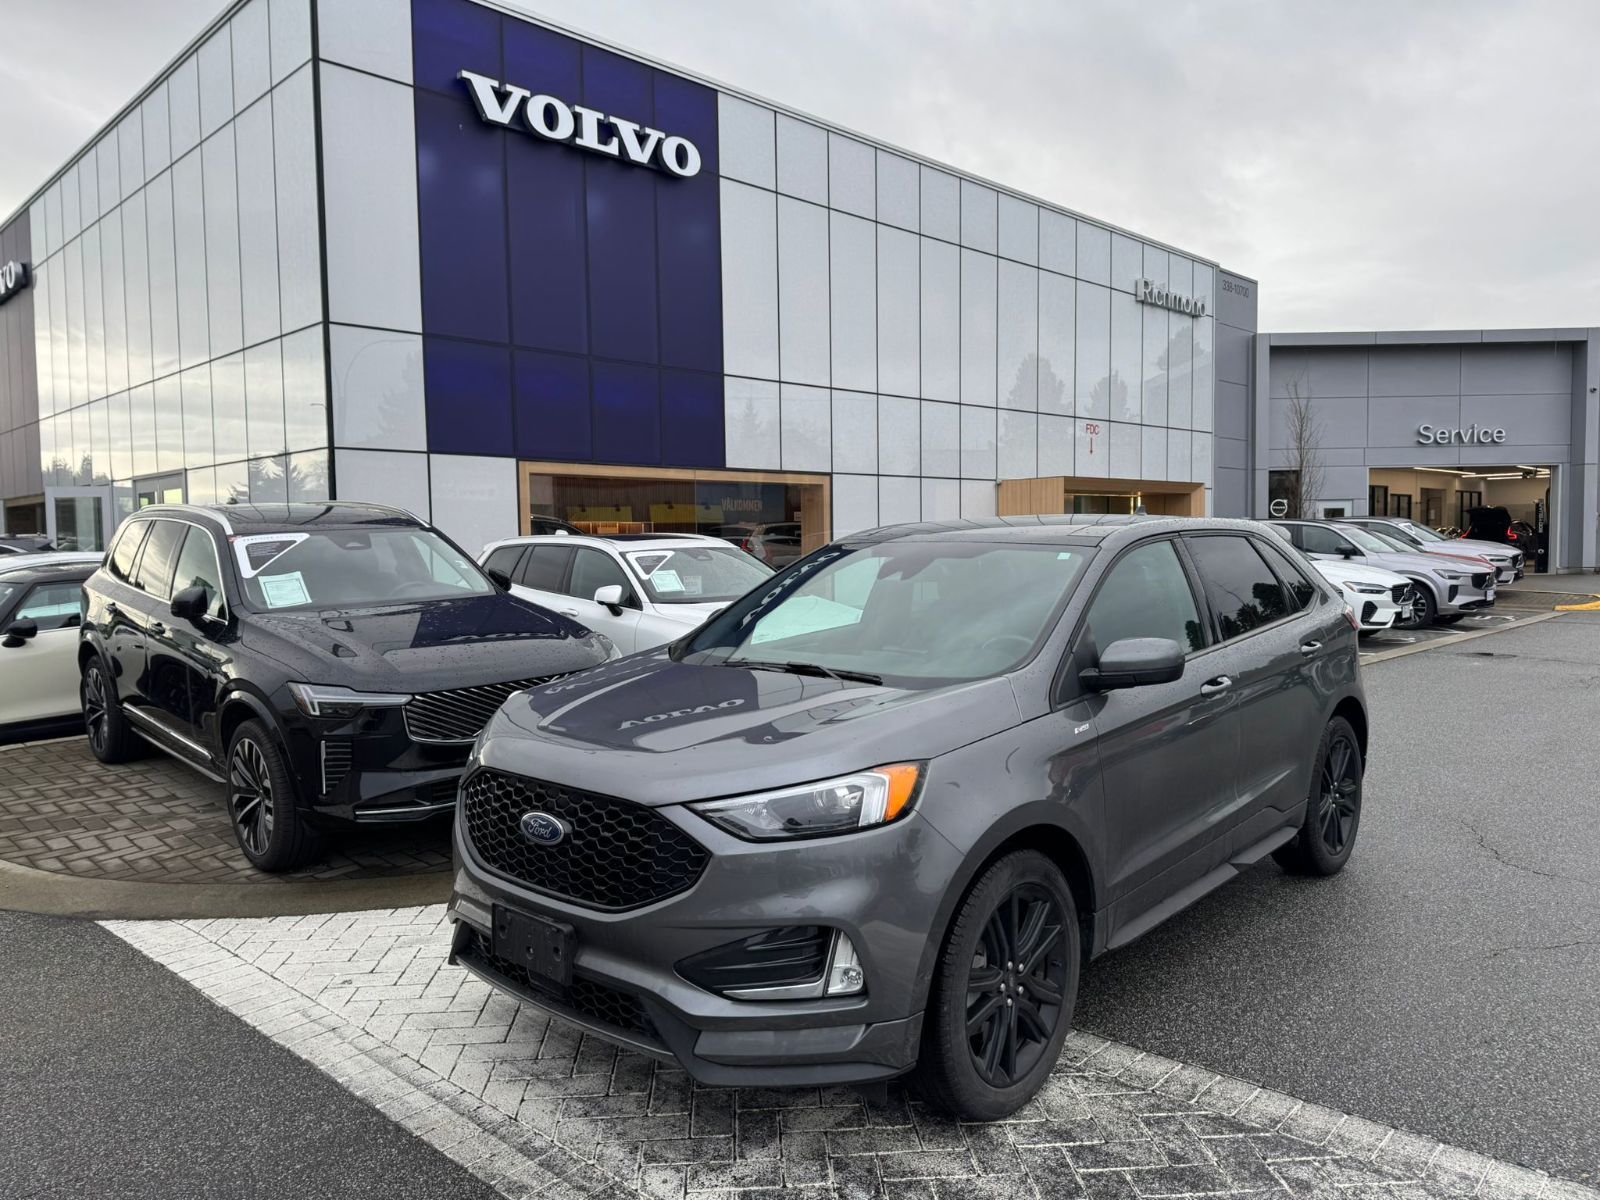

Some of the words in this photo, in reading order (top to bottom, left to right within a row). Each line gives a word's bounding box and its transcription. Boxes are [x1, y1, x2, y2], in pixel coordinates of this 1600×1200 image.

[457, 69, 702, 177] VOLVO
[1136, 278, 1207, 317] Richmond
[1086, 423, 1100, 435] FDC
[1418, 423, 1506, 444] Service
[528, 818, 552, 838] Ford
